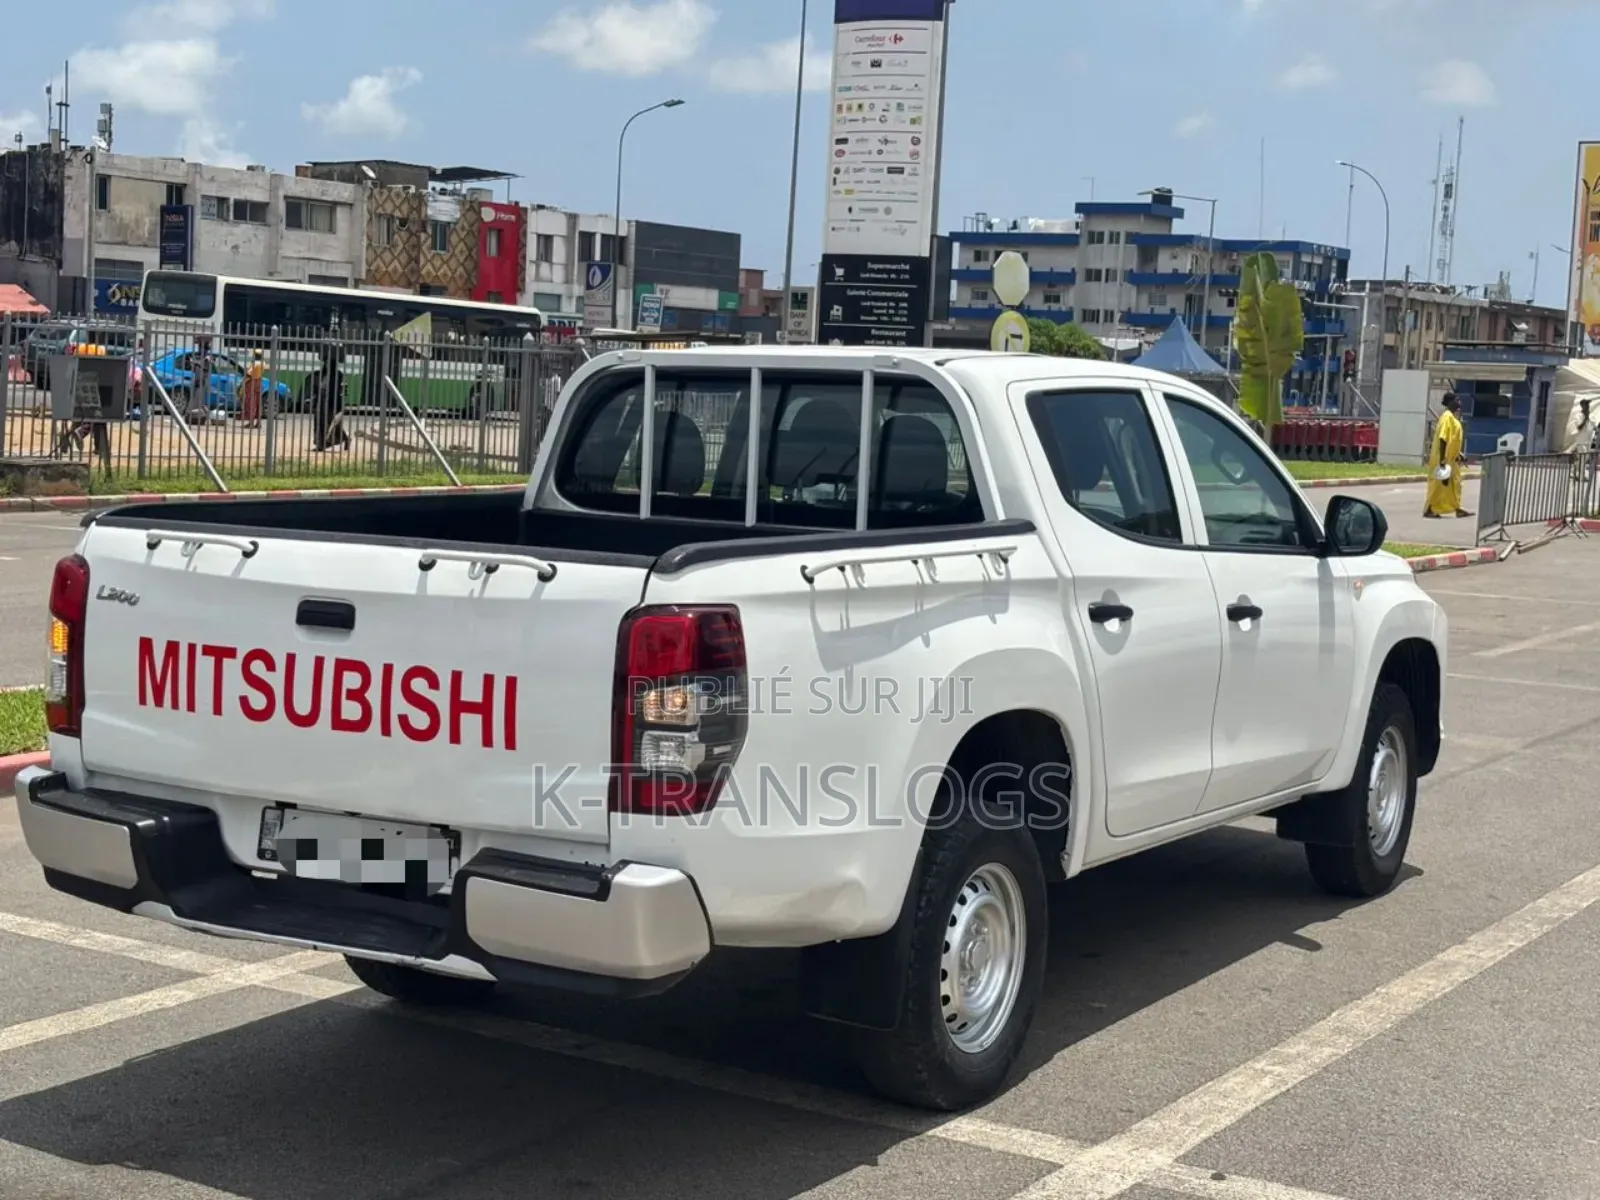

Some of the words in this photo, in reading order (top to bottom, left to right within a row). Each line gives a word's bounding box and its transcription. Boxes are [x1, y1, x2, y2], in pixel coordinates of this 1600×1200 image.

[871, 329, 906, 337] Restaurant
[96, 584, 140, 606] L200
[137, 636, 518, 751] MITSUBISHI
